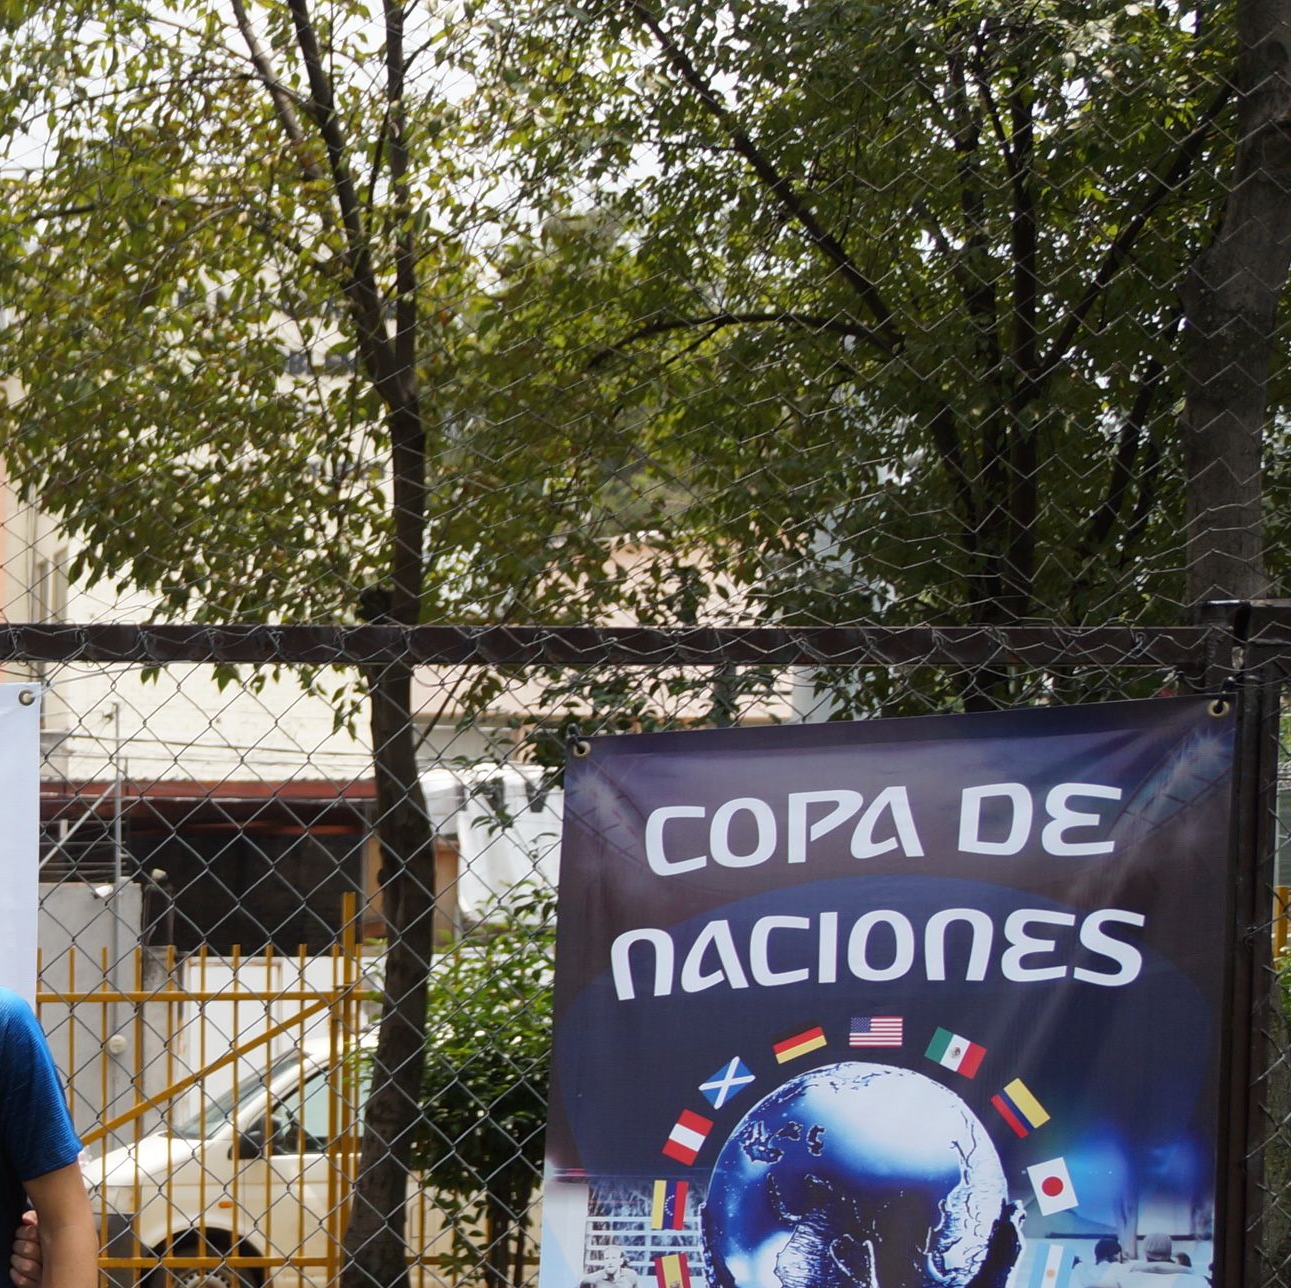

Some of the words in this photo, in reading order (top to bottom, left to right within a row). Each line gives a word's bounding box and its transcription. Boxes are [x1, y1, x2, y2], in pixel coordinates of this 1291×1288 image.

[645, 784, 924, 876] COPA
[958, 782, 1122, 856] DE
[610, 908, 1146, 1001] NACIONES
